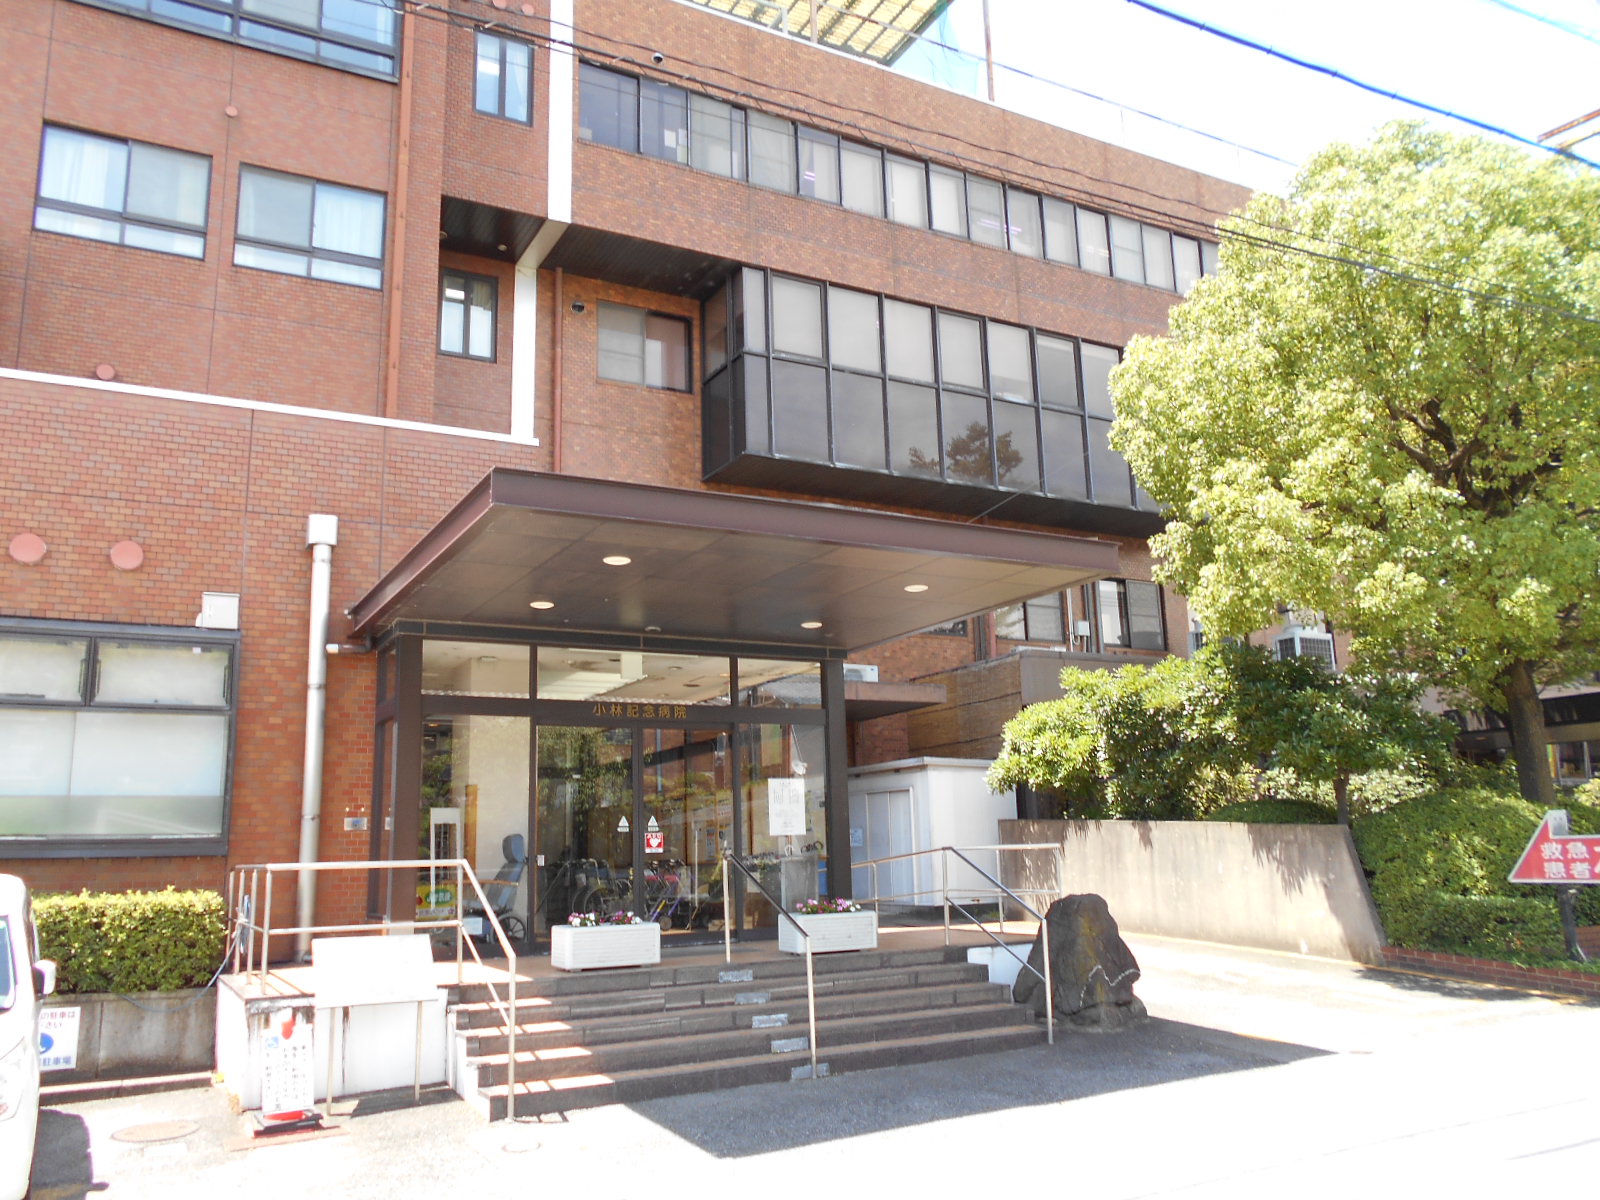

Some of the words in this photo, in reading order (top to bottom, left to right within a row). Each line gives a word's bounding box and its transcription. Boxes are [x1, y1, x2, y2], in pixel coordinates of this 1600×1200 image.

[592, 703, 687, 719] 小林記念病院
[1540, 841, 1590, 860] 救急
[1543, 861, 1591, 879] 患者
[40, 1056, 72, 1067] 駐車場
